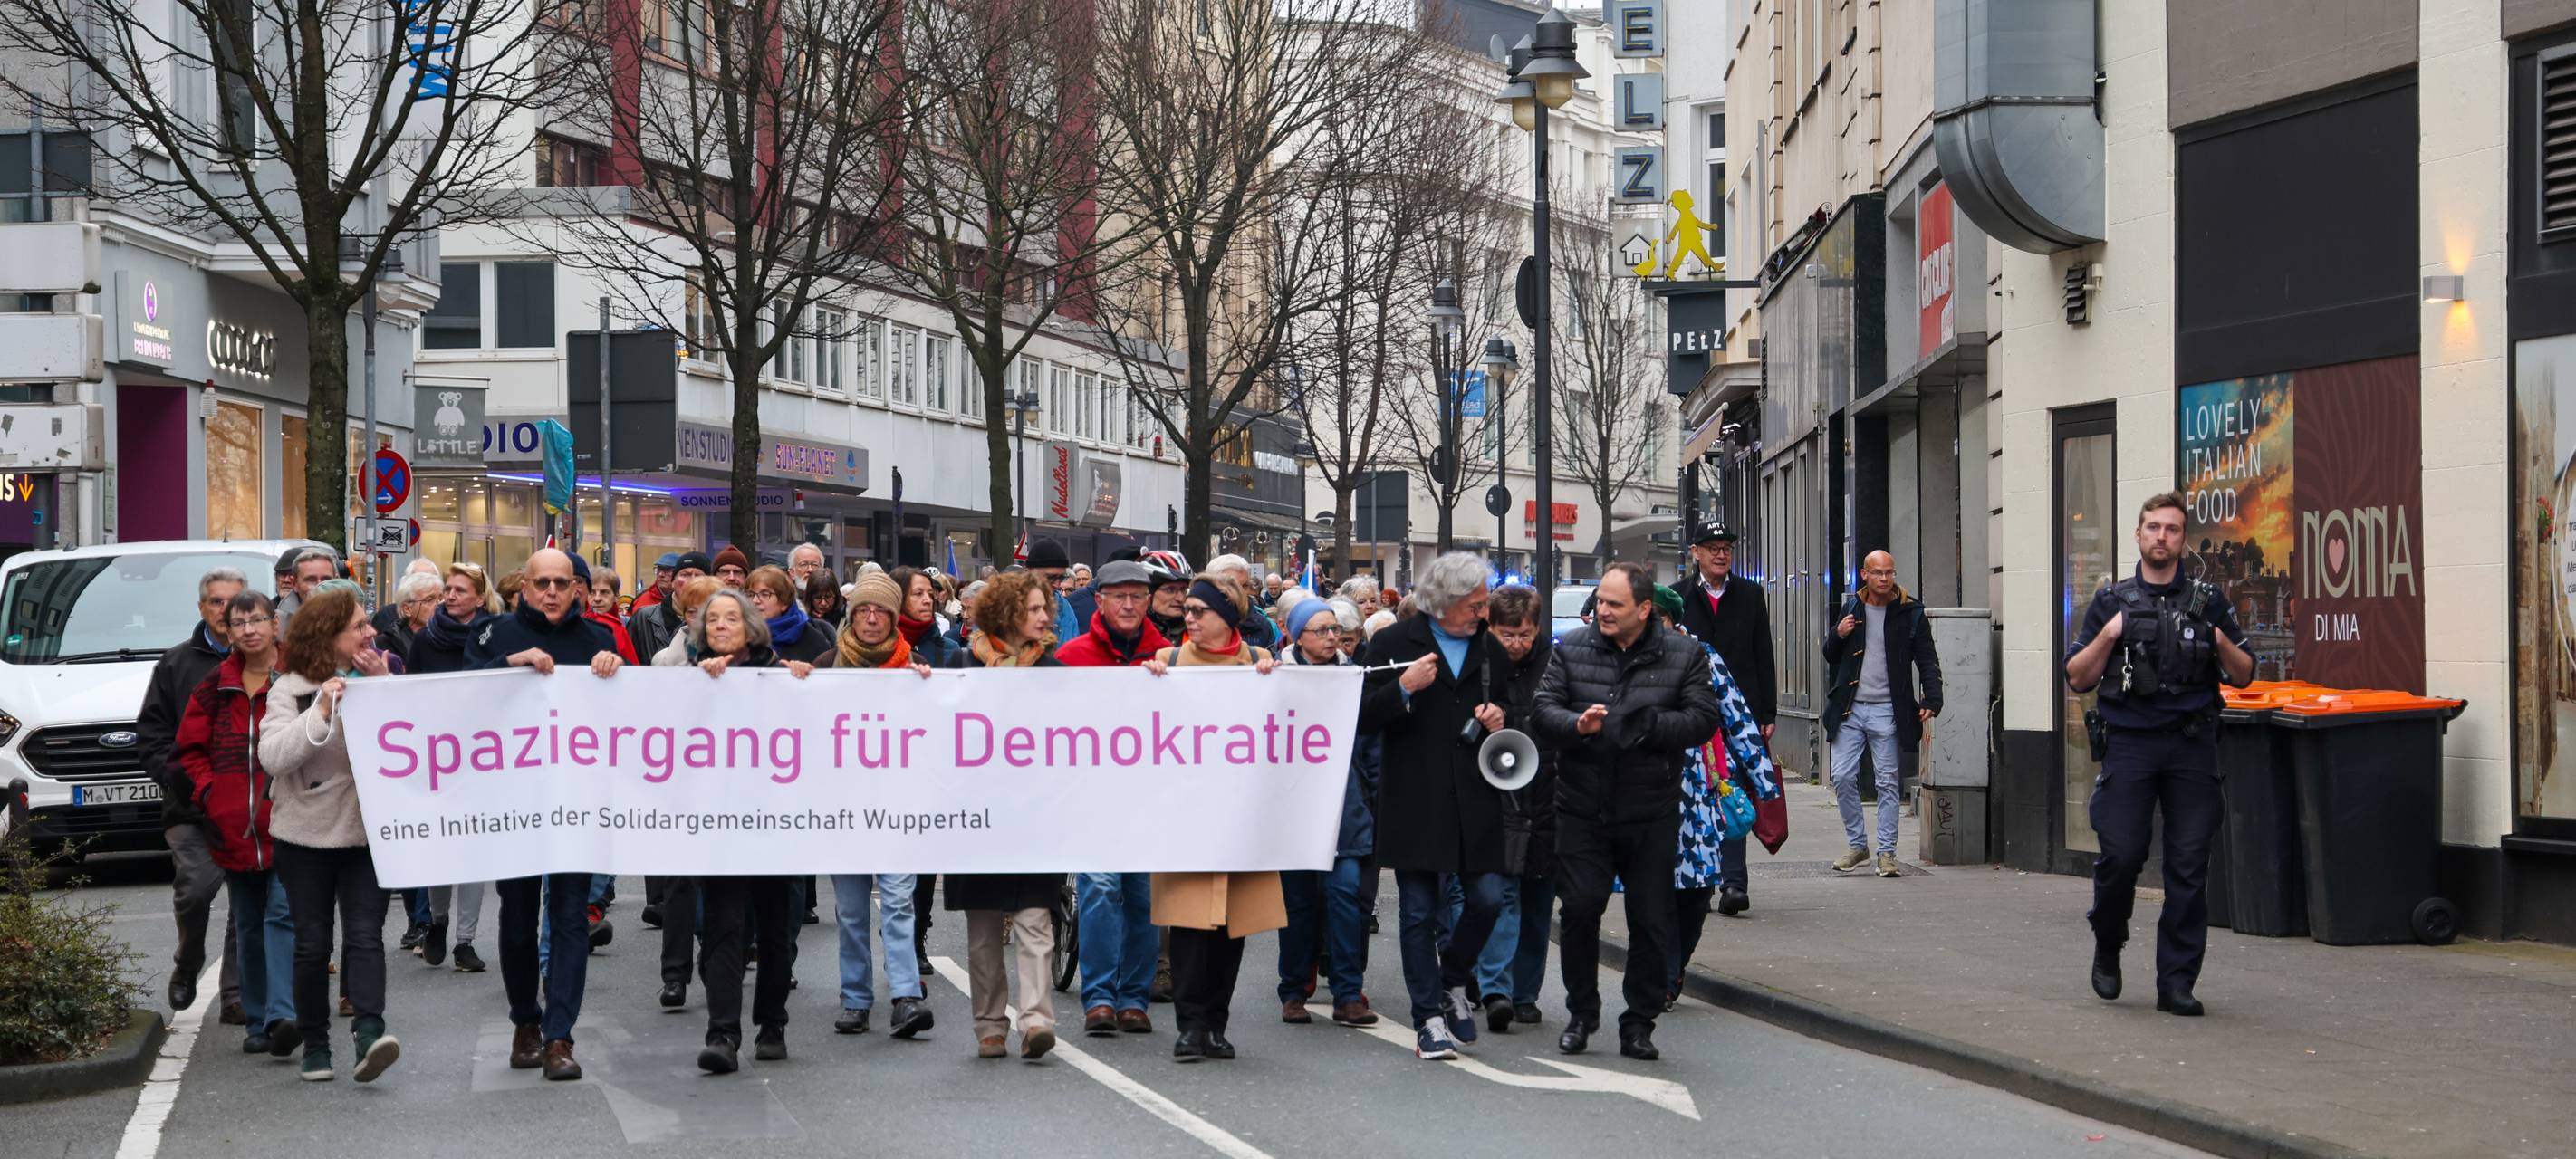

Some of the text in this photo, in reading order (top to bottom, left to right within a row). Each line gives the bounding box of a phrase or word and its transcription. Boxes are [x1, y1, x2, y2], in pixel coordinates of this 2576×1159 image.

[1673, 330, 1721, 351] PELZ
[2186, 398, 2261, 441] LOVELY
[775, 443, 837, 476] SUN-PLANET
[2186, 442, 2261, 483] ITALIAN
[2186, 487, 2237, 524] FOOD
[2303, 504, 2417, 599] NONNA
[2315, 613, 2360, 641] DI MIA
[108, 733, 131, 743] Ford
[377, 709, 1331, 791] Spaziergang für Demokratie
[83, 790, 93, 802] M
[105, 786, 124, 801] VT
[380, 805, 992, 840] eine Initiative der Solidargemeinschaft Wuppertal
